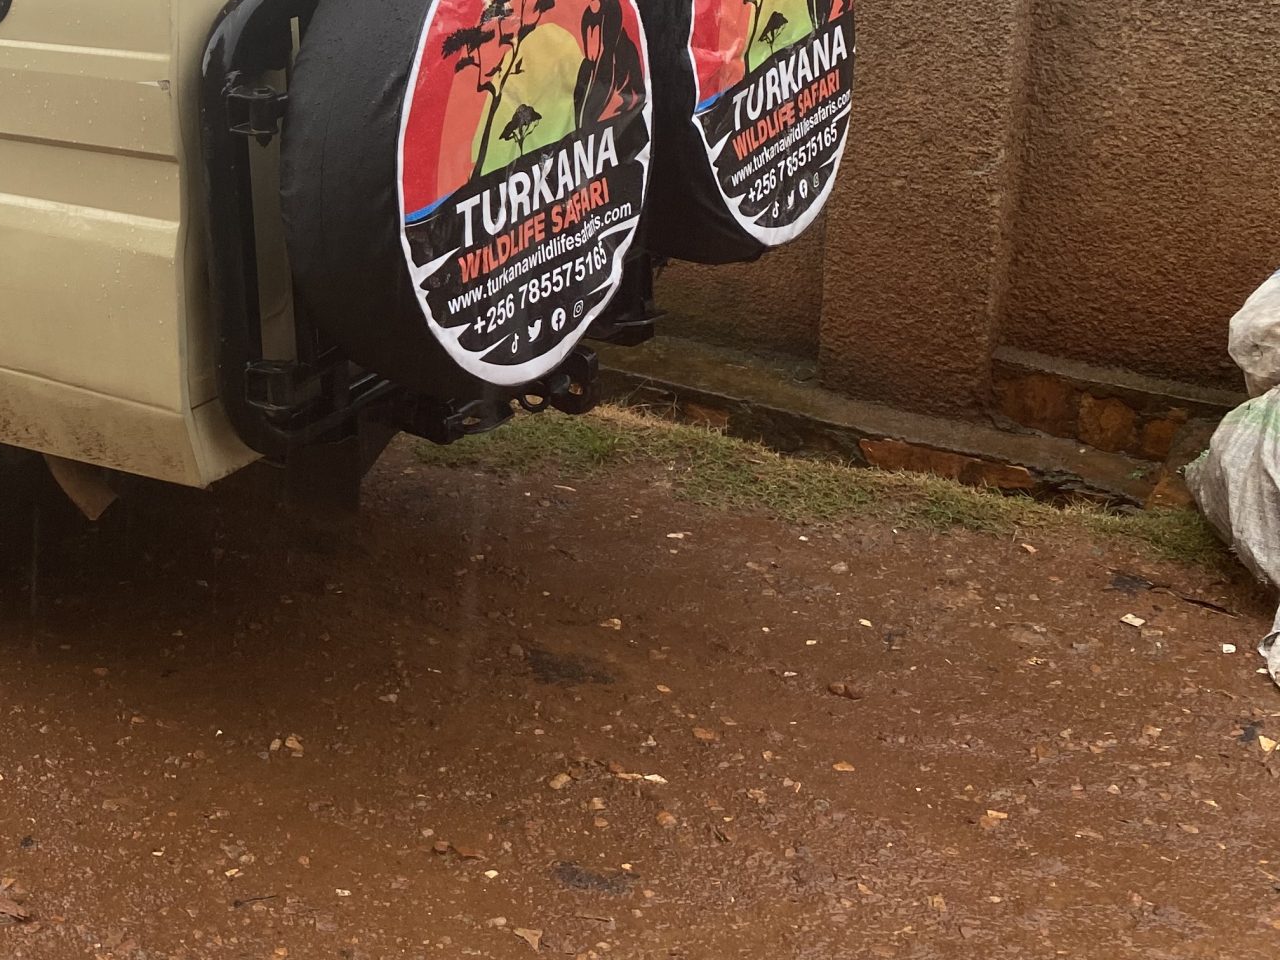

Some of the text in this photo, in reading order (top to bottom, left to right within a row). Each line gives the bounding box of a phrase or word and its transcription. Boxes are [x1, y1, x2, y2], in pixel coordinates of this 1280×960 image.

[732, 25, 848, 131] TURKANA
[732, 68, 840, 161] WILDLIFE SAFARI
[456, 126, 619, 248] TURKANA
[748, 122, 838, 203] +256 785575165
[447, 202, 632, 315] www.turkanawildlifesafaris.com
[458, 177, 610, 284] WILDLIFE SAFARI
[473, 240, 608, 337] +256 785575165
